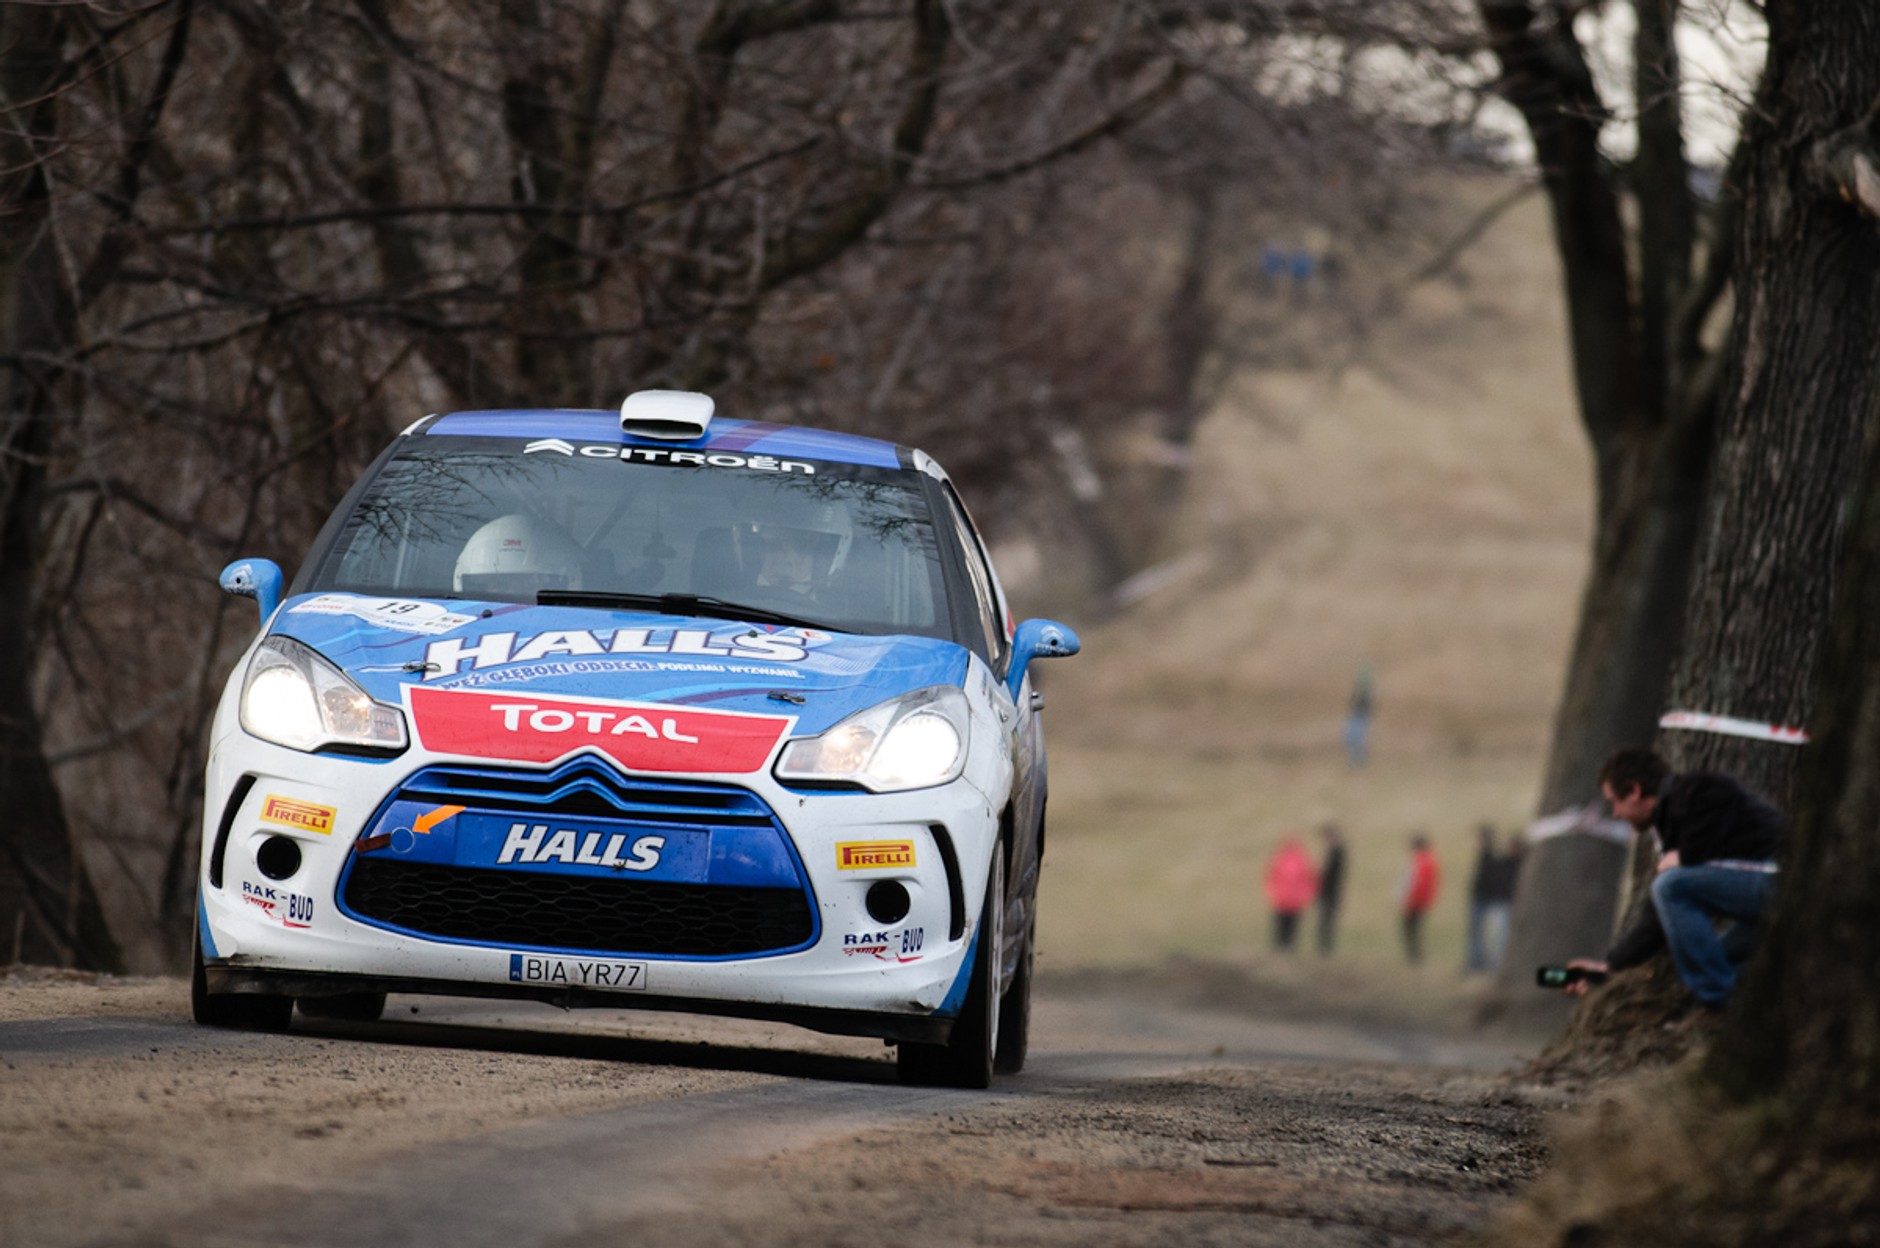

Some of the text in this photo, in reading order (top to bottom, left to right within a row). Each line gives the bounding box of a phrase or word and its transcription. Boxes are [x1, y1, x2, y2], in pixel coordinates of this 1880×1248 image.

[376, 602, 420, 614] 19
[421, 629, 810, 682] HALLS
[490, 704, 699, 744] TOTAL
[265, 799, 331, 829] PIRELLI
[496, 823, 666, 871] HALLS
[842, 845, 910, 865] PIRELLI
[526, 958, 641, 987] BIA YR77
